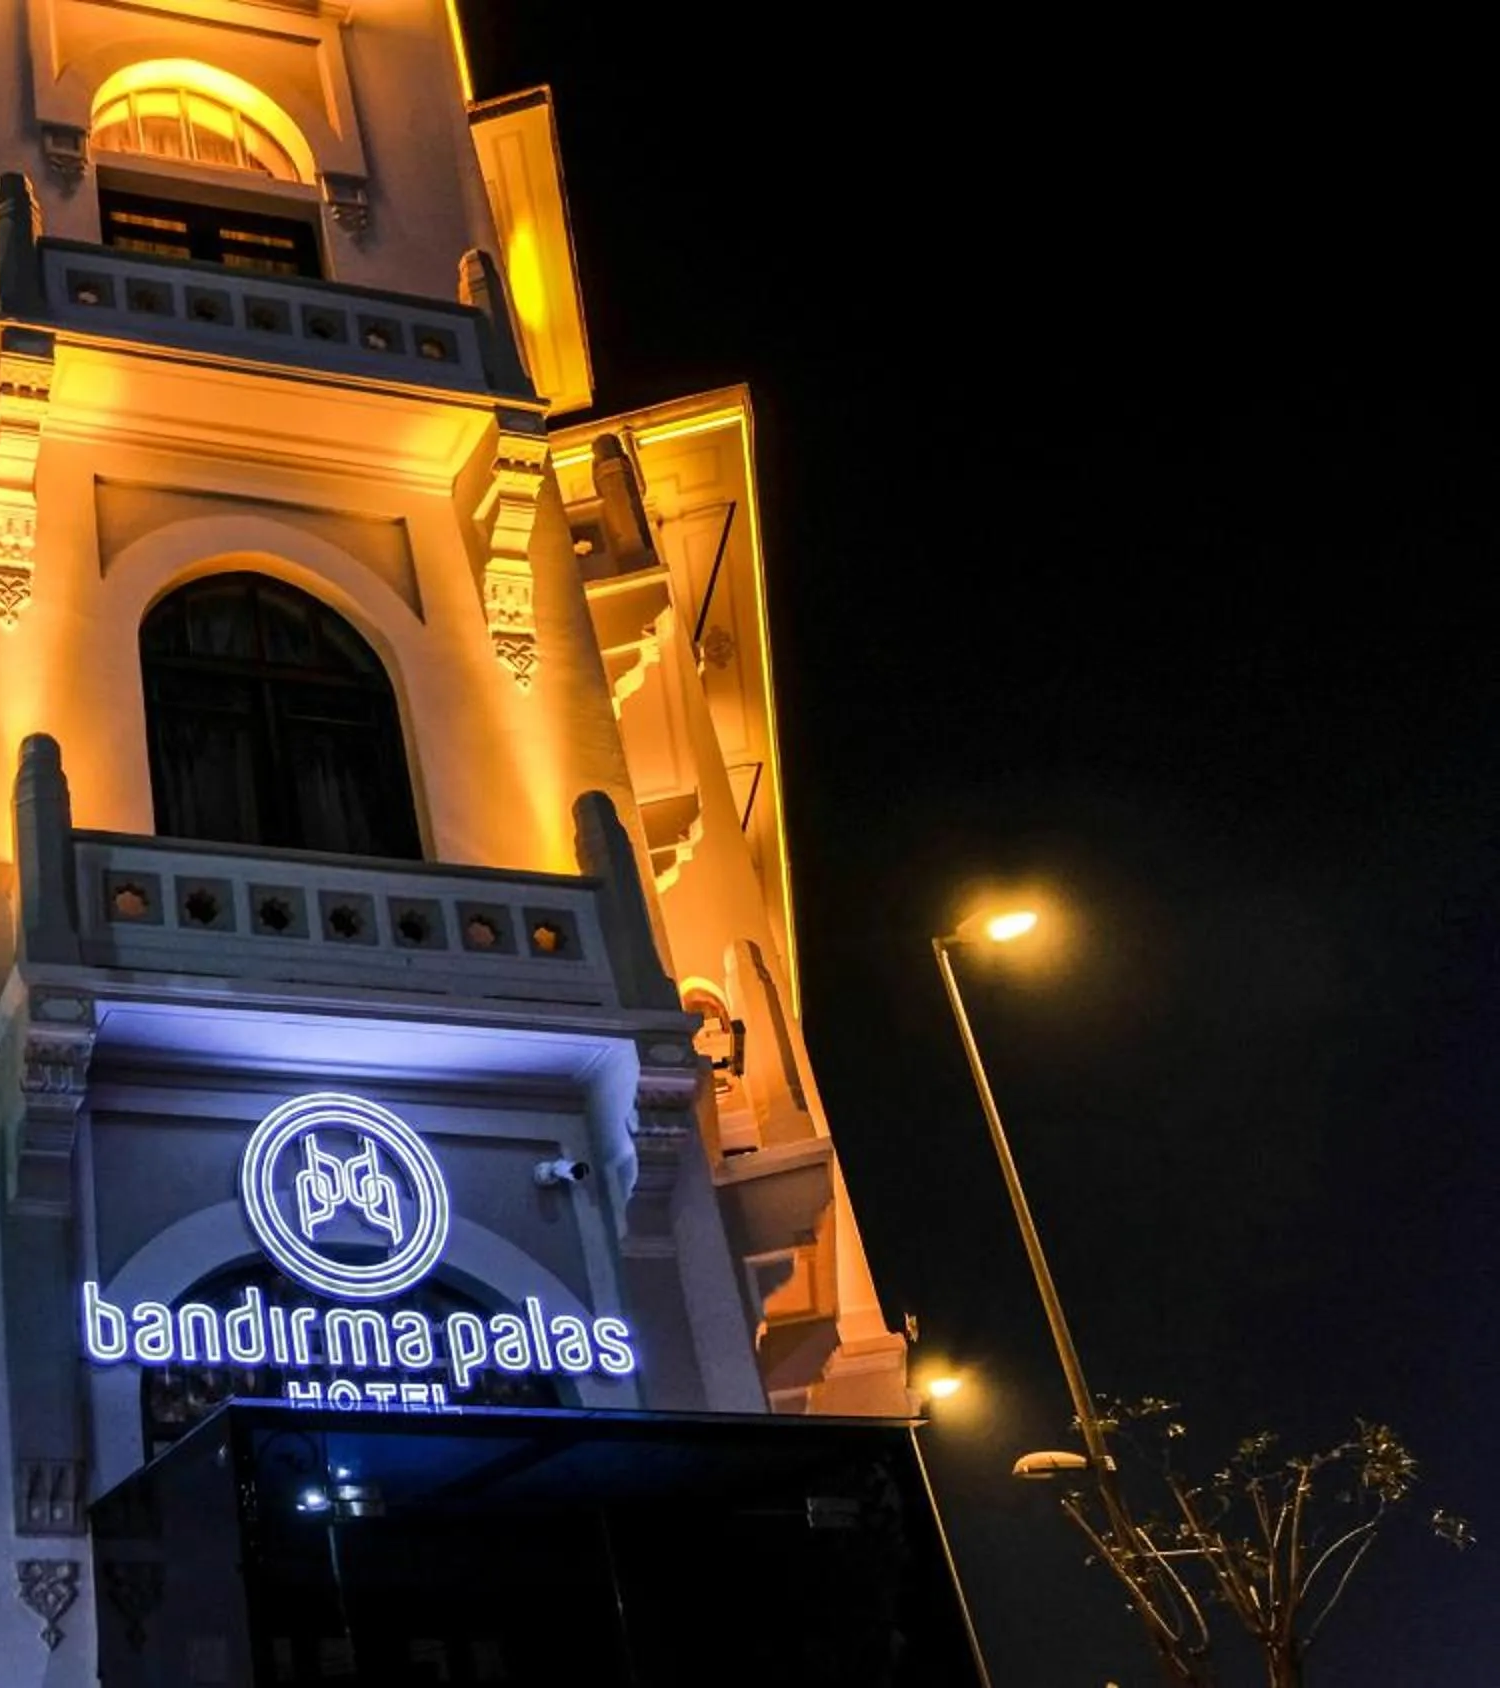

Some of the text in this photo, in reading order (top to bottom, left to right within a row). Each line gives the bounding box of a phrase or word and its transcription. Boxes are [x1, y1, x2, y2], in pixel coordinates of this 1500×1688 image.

[83, 1281, 636, 1388] bandırma palas
[287, 1379, 463, 1414] HOTEL
